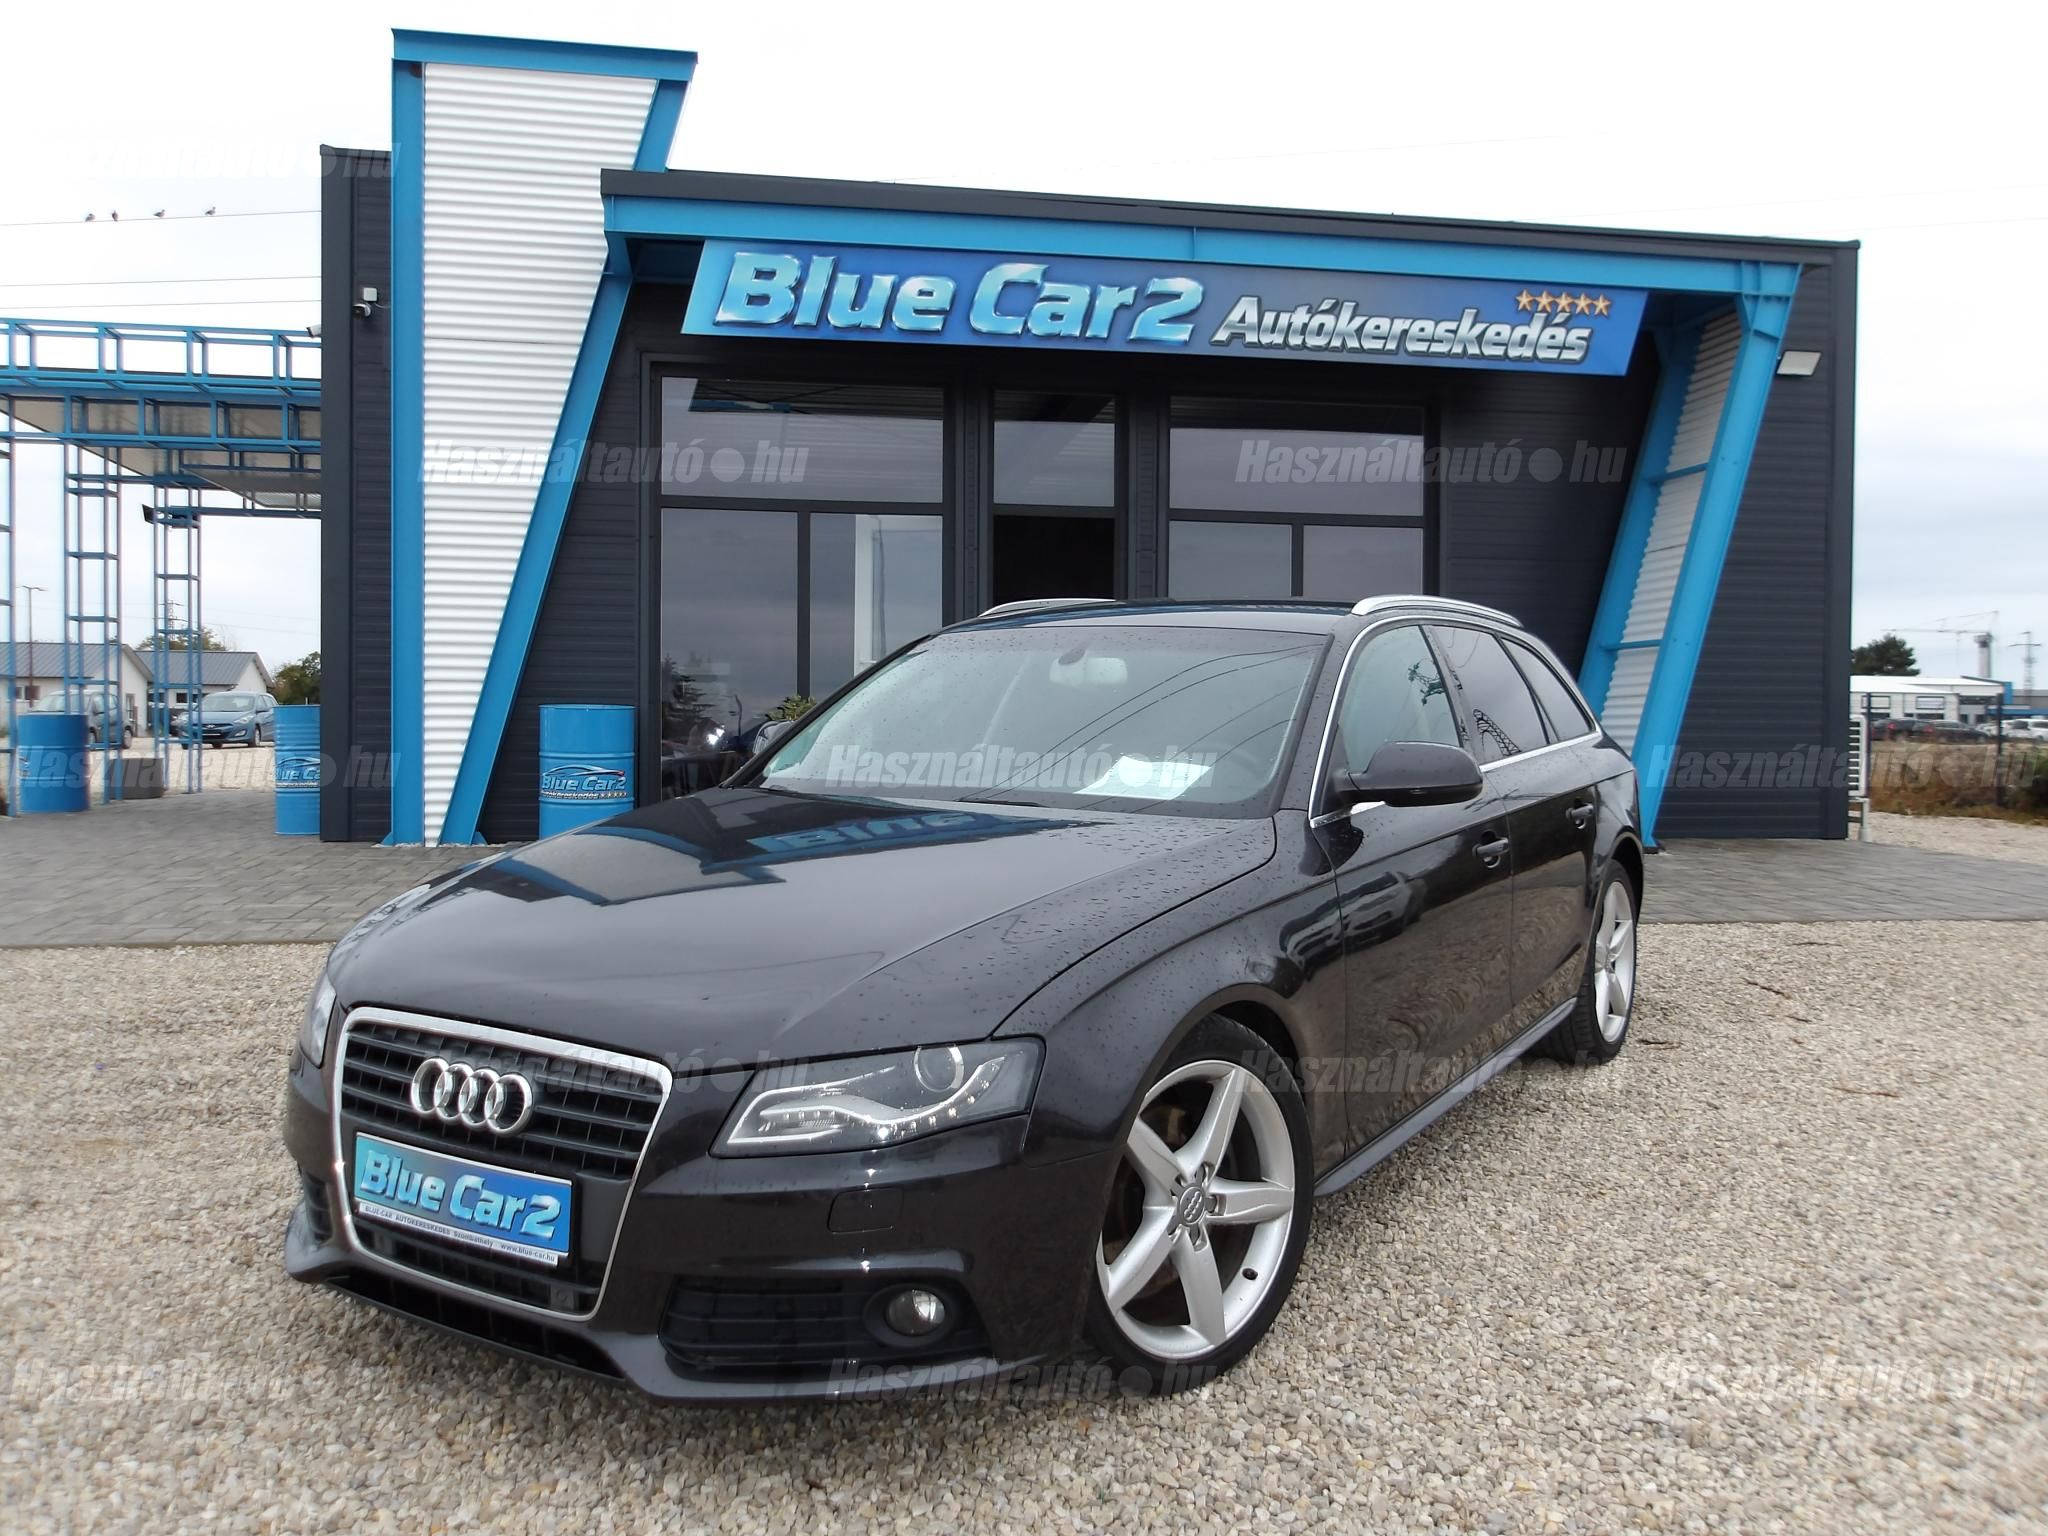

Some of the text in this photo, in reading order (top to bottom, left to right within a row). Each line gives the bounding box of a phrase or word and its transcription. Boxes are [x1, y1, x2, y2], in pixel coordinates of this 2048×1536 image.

[713, 250, 1205, 346] Blue Car2
[1210, 295, 1594, 364] Autókereskedés
[542, 775, 626, 791] Blue Car2
[360, 1150, 561, 1239] Blue Car2
[501, 1243, 555, 1262] www.blue-car.hu
